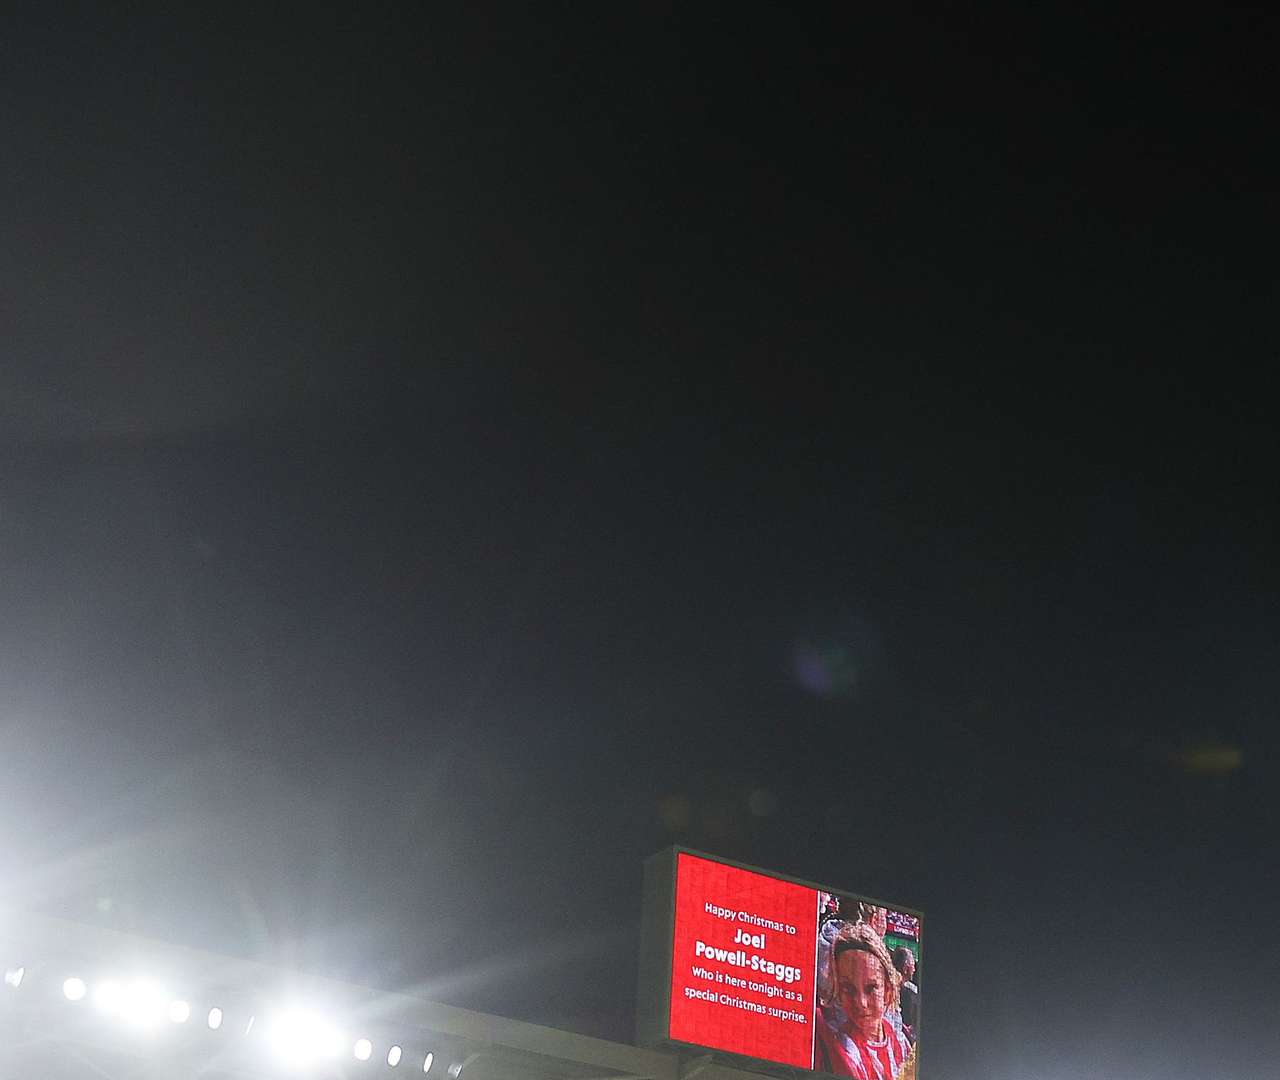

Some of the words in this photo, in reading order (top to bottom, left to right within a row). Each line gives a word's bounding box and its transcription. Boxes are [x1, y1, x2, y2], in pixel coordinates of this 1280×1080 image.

[704, 902, 737, 921] Happy
[738, 911, 784, 932] Christmas
[786, 924, 797, 935] to
[734, 928, 766, 949] Joel
[695, 940, 801, 984] Powell-Staggs
[692, 966, 714, 979] Who
[715, 971, 723, 983] is
[725, 974, 747, 989] here
[748, 981, 784, 998] tonight
[785, 990, 796, 1001] as
[797, 992, 803, 1002] a
[684, 987, 719, 1003] special
[720, 994, 767, 1015] Christmas
[768, 1007, 808, 1024] surprise.
